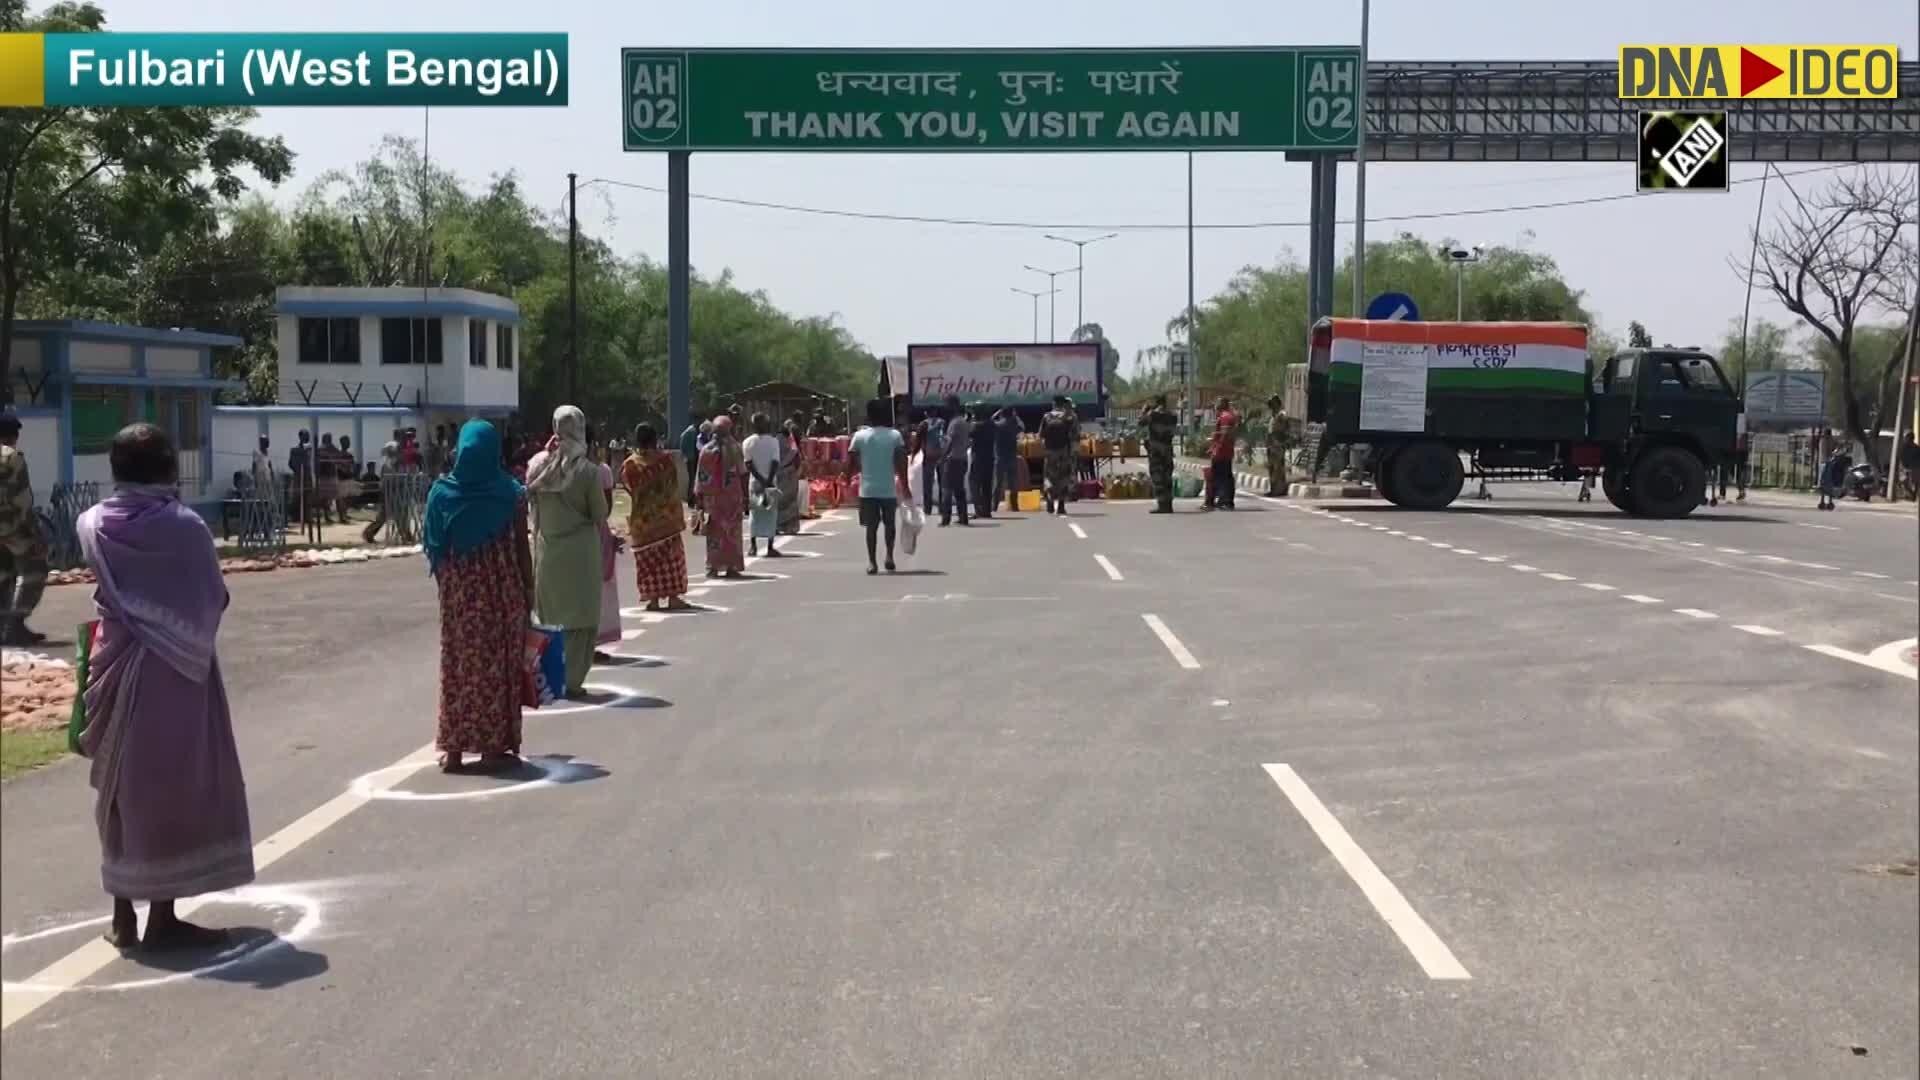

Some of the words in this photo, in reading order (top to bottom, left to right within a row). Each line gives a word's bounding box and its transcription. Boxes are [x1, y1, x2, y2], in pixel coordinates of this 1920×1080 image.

[632, 64, 677, 95] AH
[1087, 60, 1183, 96] पधारें
[1307, 61, 1354, 93] AH
[632, 99, 677, 129] 02
[744, 111, 883, 139] THANK
[895, 111, 988, 143] YOU,
[1000, 111, 1104, 138] VISIT
[1116, 111, 1240, 138] AGAIN
[1306, 97, 1353, 129] 02
[919, 374, 995, 399] Fighter
[1000, 374, 1049, 399] Fifty
[1054, 374, 1093, 392] One
